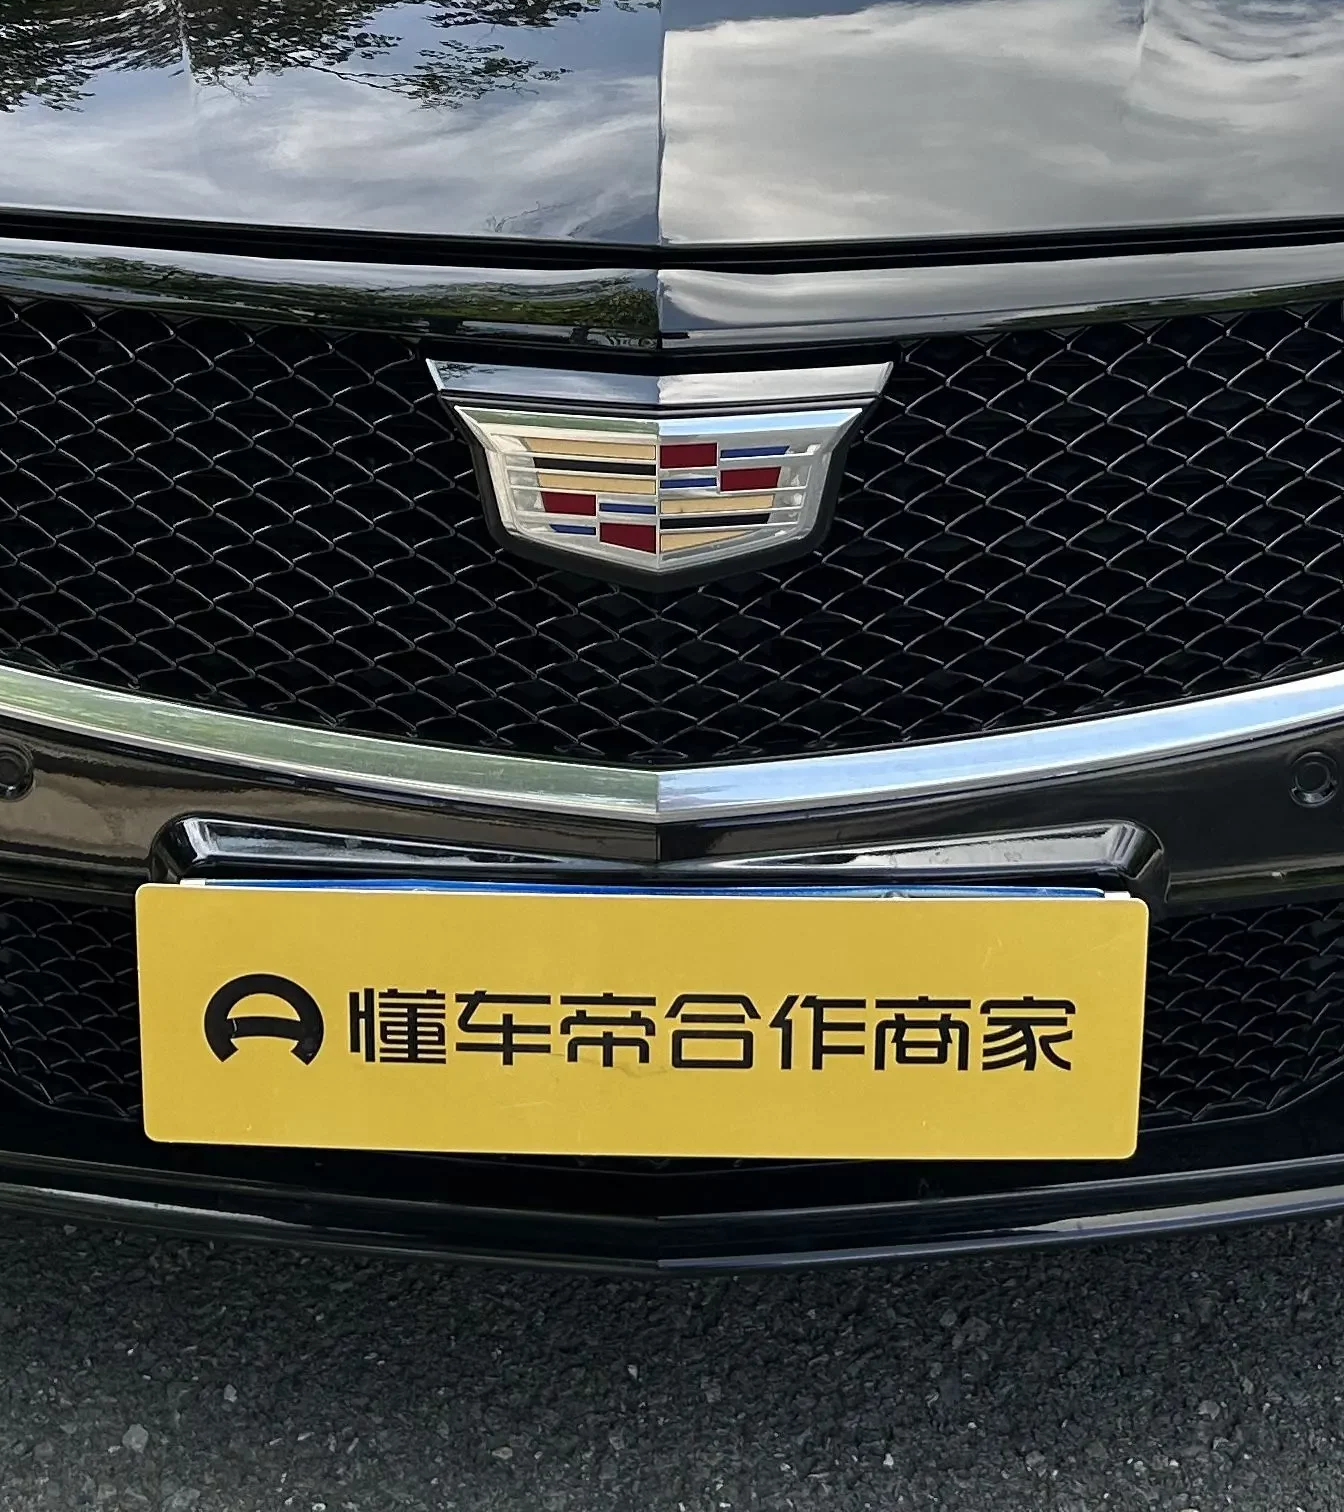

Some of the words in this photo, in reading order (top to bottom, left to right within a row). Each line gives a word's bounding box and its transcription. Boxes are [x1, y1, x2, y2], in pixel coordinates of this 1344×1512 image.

[349, 987, 1076, 1072] 懂车帝合作商家
